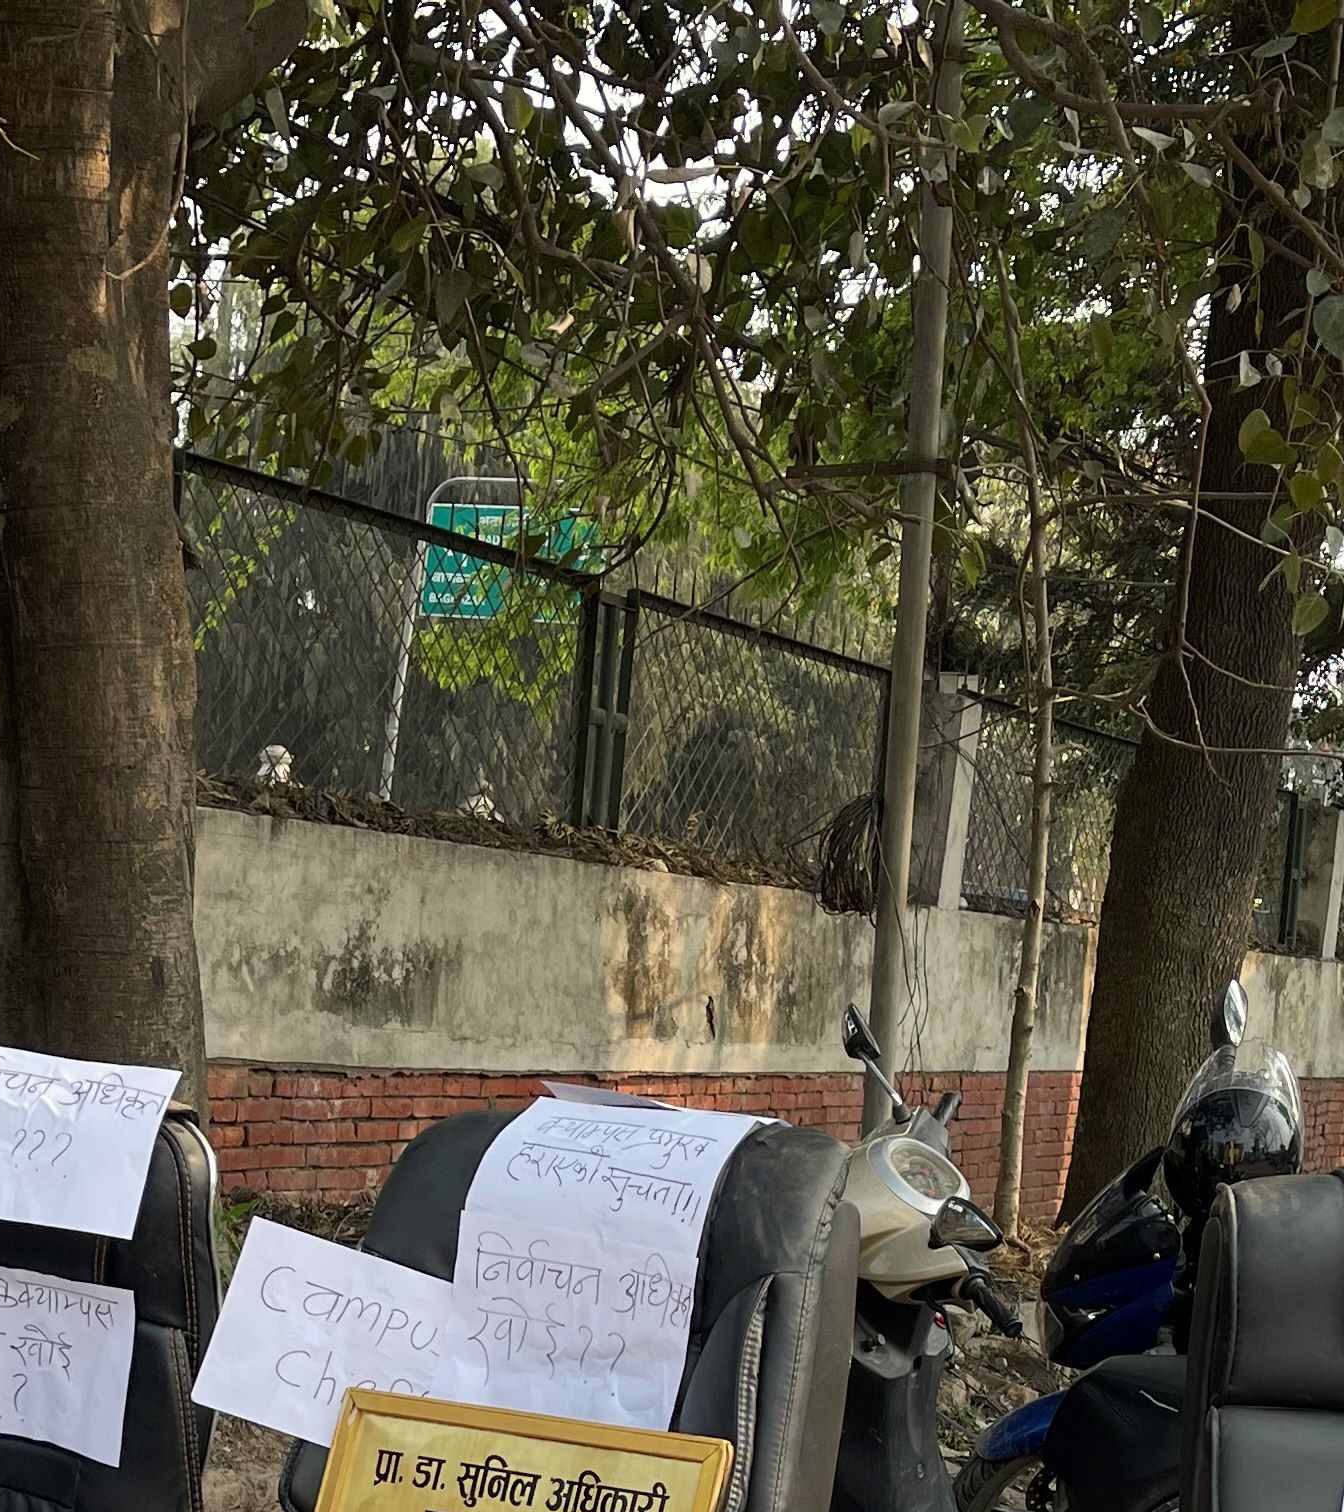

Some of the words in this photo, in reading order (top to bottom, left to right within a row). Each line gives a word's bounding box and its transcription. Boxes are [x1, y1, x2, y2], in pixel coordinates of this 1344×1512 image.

[259, 1264, 442, 1359] Campu
[372, 1447, 405, 1488] प्रा.
[412, 1453, 448, 1493] डा.
[456, 1454, 543, 1509] सुनिल
